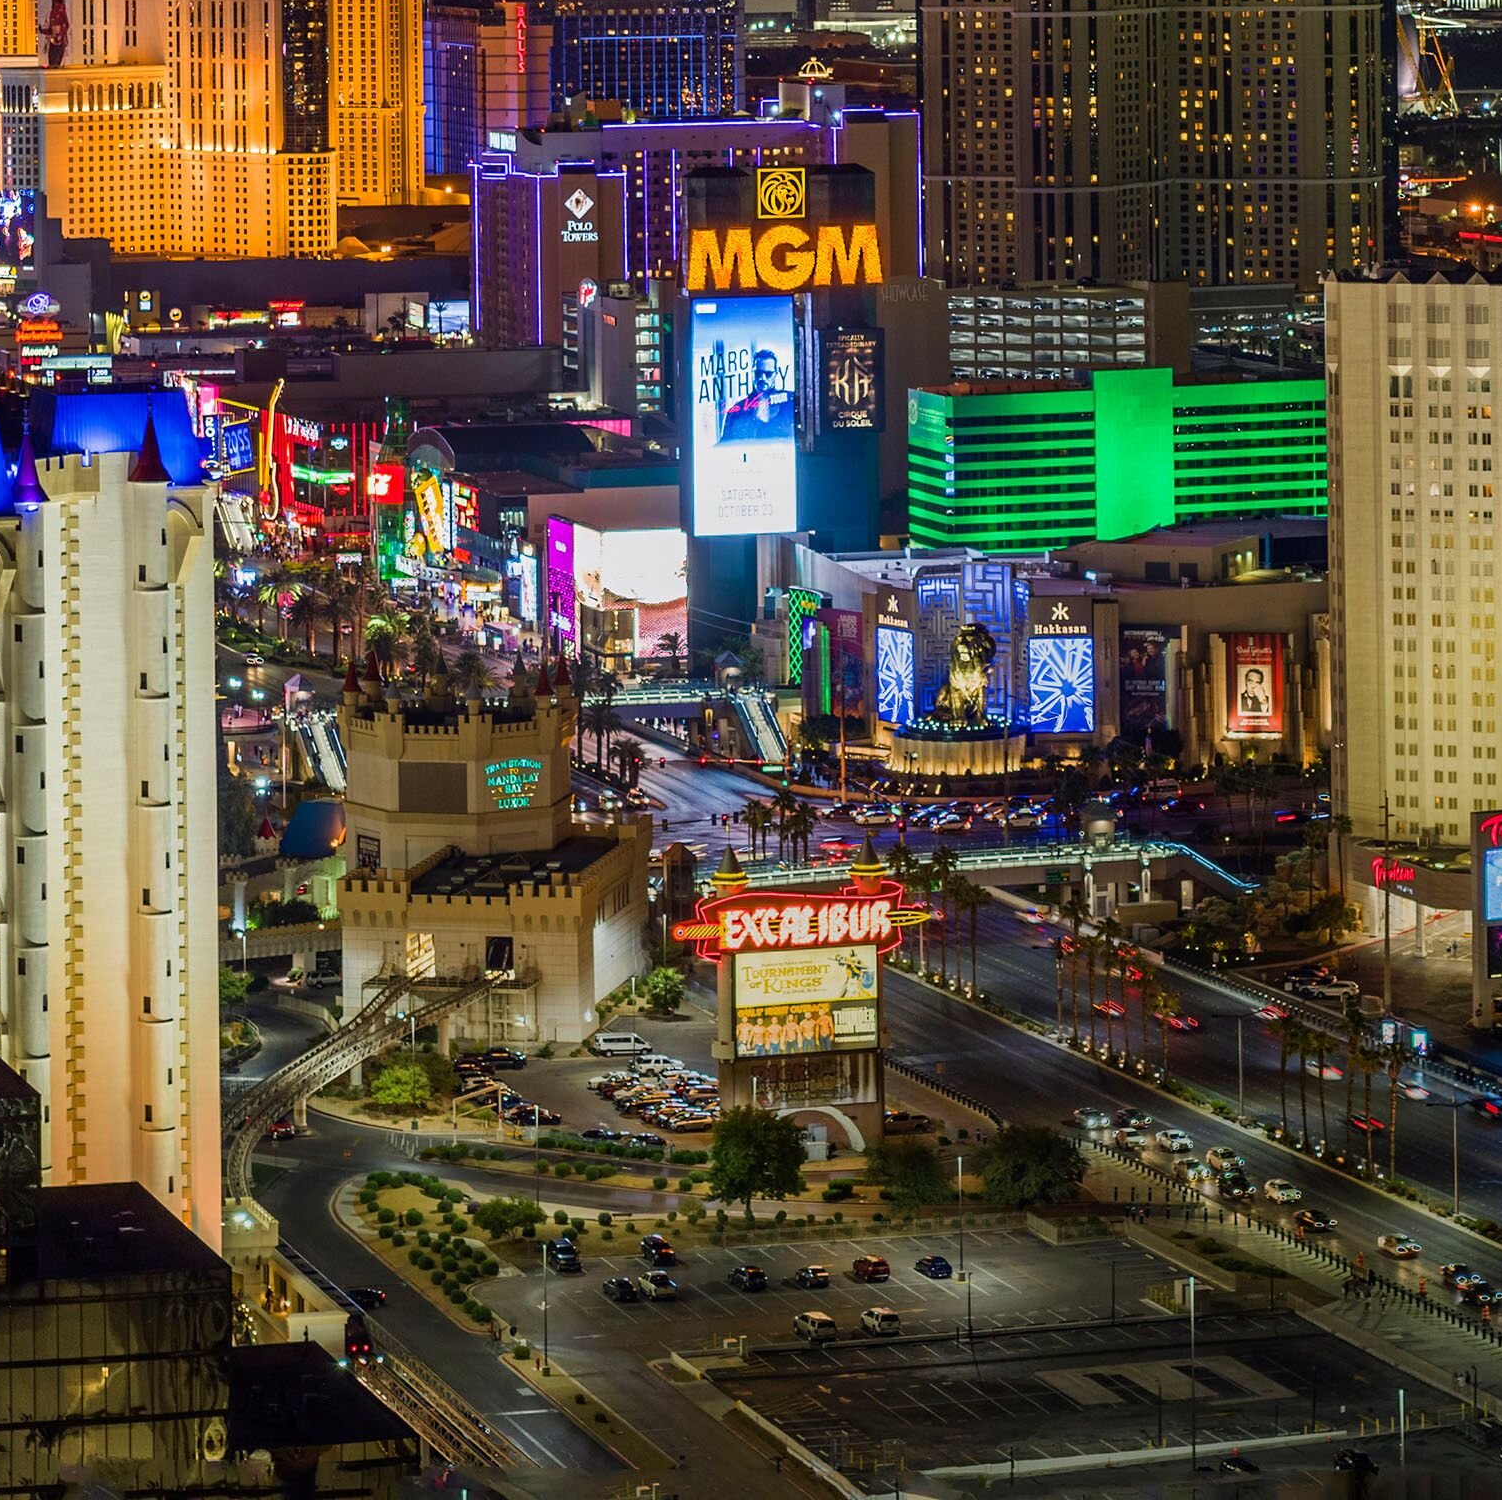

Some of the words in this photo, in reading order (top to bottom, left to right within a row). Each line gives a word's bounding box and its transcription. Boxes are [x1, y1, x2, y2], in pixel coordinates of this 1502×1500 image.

[687, 224, 884, 292] MGM
[882, 284, 930, 302] SHOWCASE
[700, 349, 749, 378] MARC
[699, 365, 790, 404] ANTHY
[838, 409, 868, 420] CIRQUE
[833, 419, 844, 429] DU
[845, 418, 873, 428] SOLEIL
[721, 487, 767, 502] SATURDAY
[717, 504, 759, 518] OCTOBER
[762, 503, 774, 516] 23
[878, 614, 909, 628] Hakkasan
[1034, 624, 1087, 635] Hakkasan
[484, 761, 508, 775] TRAM
[508, 758, 542, 770] STATION
[508, 767, 519, 775] TO
[487, 772, 540, 787] MANDALAY
[504, 783, 522, 794] BAY
[725, 900, 892, 949] EXCALIBUR
[832, 1008, 875, 1026] THUNDER
